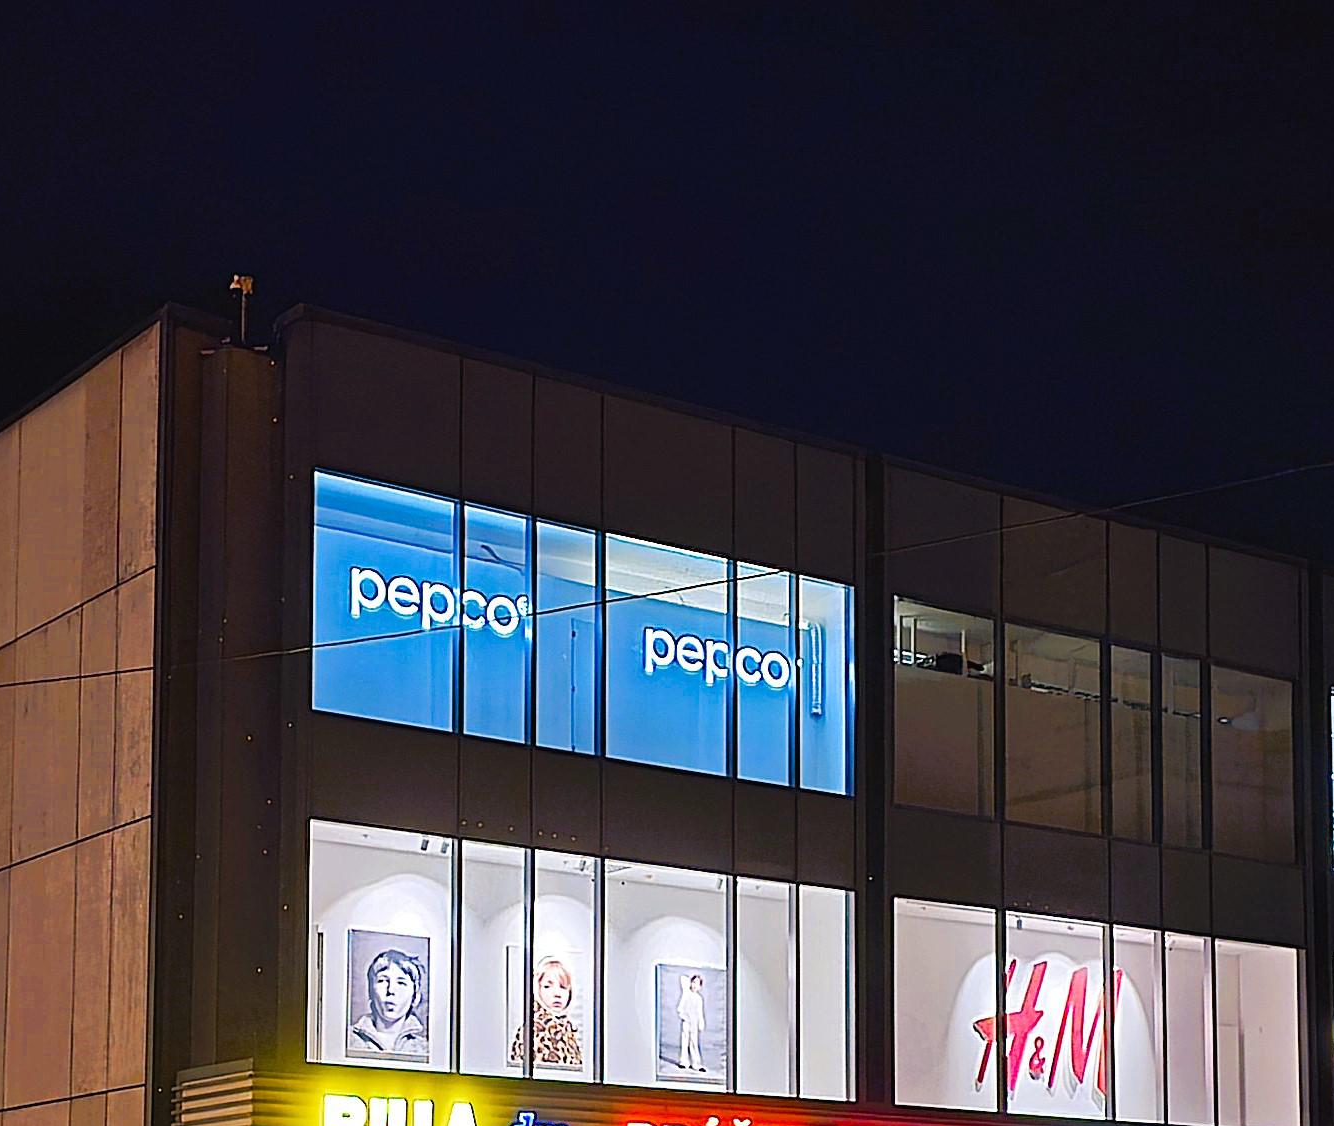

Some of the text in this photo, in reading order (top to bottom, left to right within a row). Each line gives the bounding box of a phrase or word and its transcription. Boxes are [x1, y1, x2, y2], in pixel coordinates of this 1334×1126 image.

[349, 566, 521, 636] pepco
[643, 626, 791, 689] pepco
[973, 959, 1123, 1095] H&M
